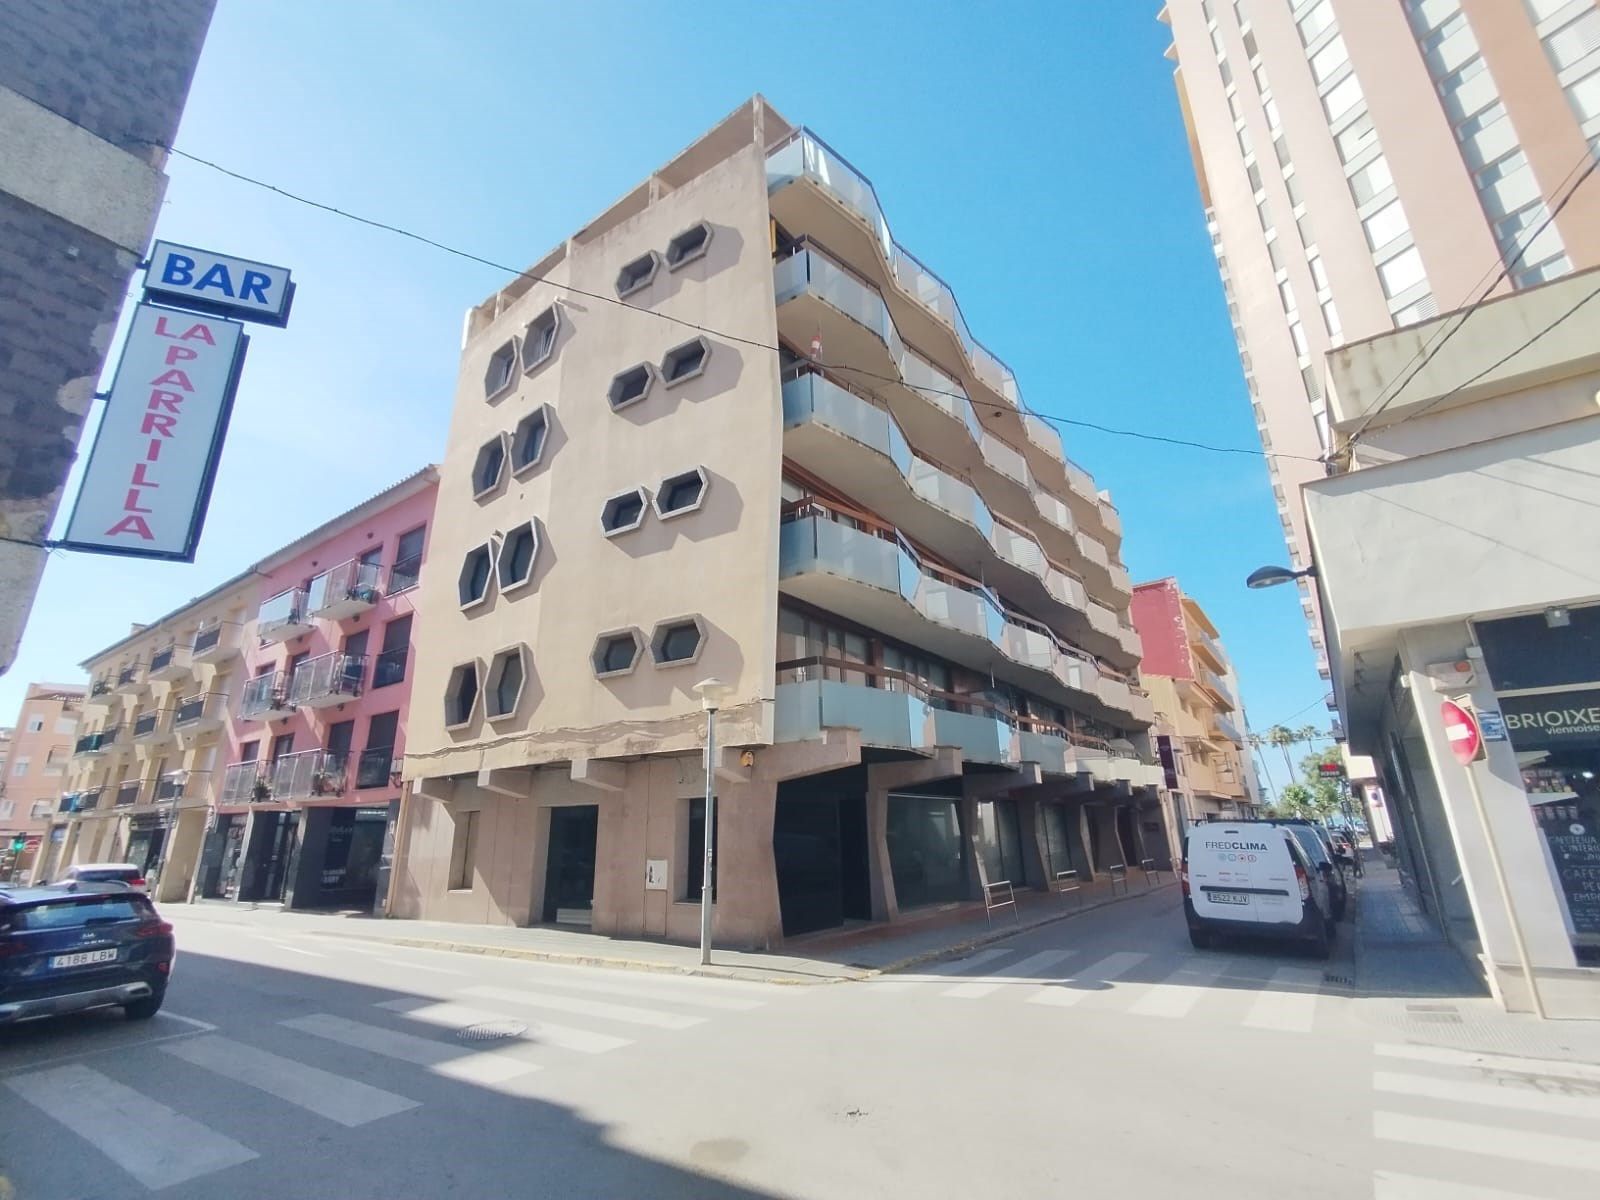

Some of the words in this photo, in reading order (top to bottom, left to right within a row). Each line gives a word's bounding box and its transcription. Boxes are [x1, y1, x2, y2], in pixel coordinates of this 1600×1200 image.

[161, 252, 272, 304] BAR
[154, 317, 216, 346] LA
[104, 345, 198, 541] PARRILLA
[1205, 841, 1268, 851] FREDCLIMA
[56, 953, 88, 966] 4188
